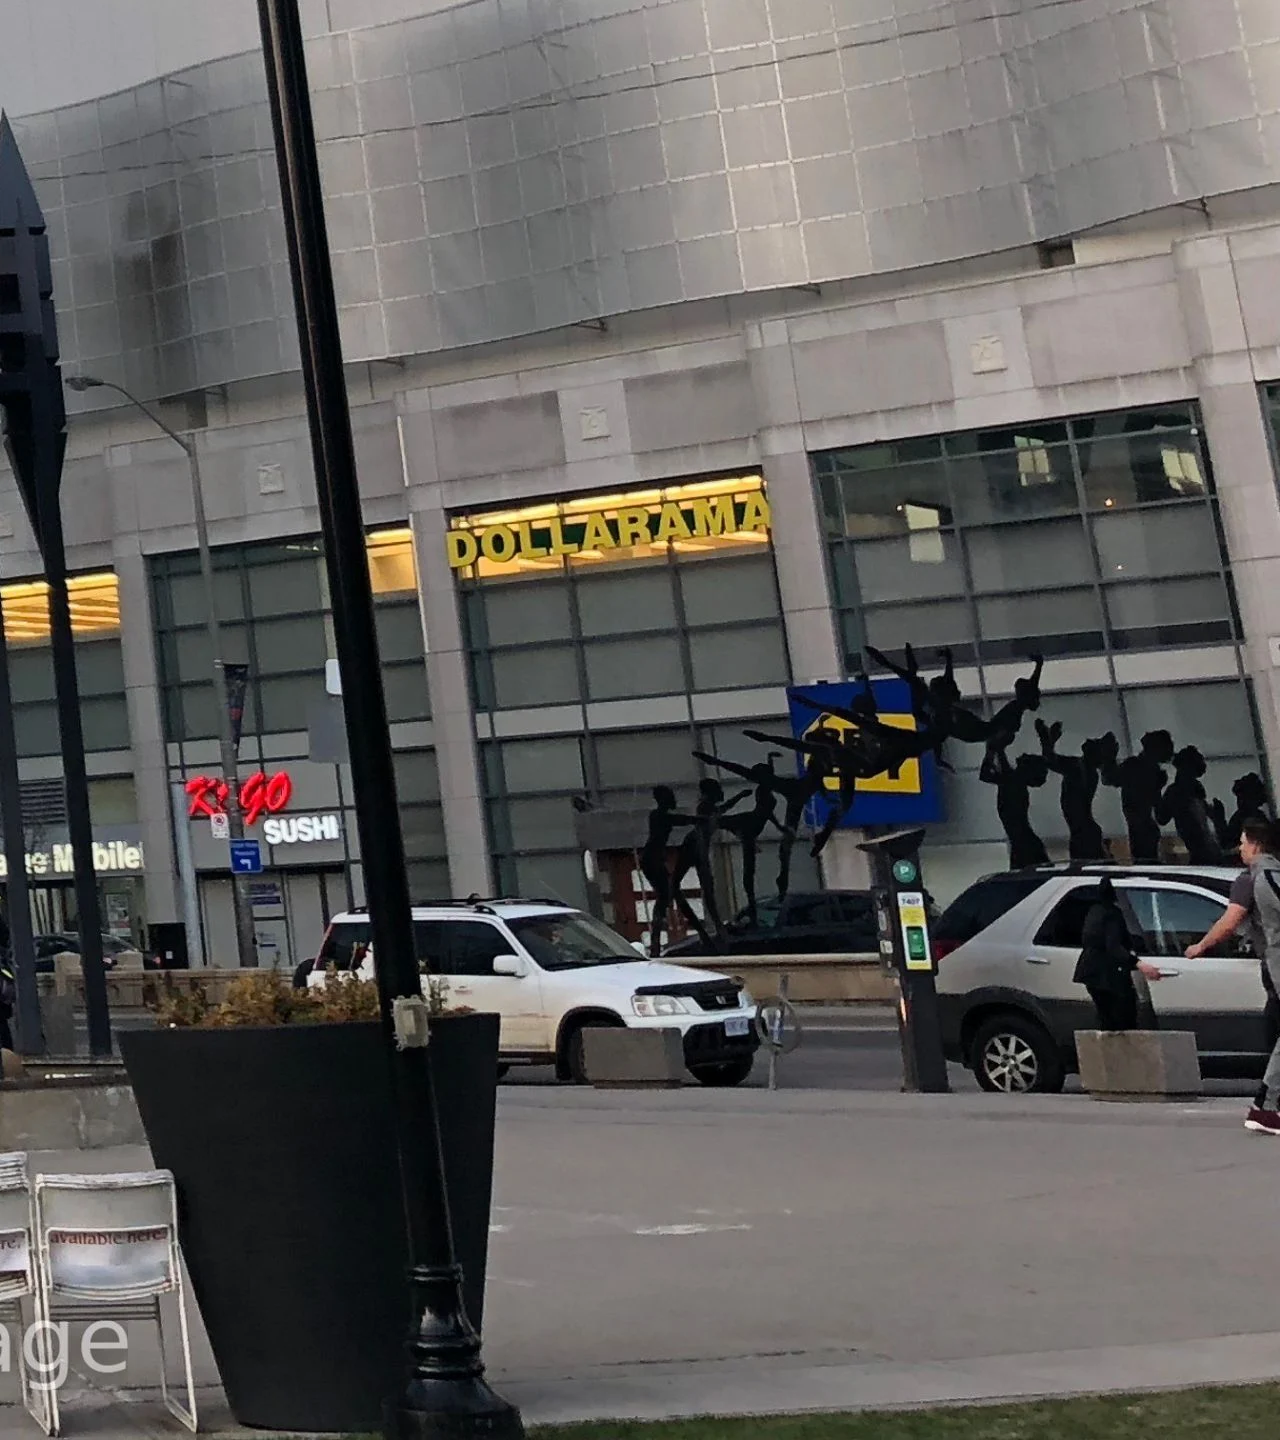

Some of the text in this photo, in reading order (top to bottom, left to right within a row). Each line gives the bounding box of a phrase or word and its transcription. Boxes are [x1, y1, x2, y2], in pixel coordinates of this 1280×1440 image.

[445, 490, 772, 569] DOLLARAMA
[263, 814, 340, 845] SUSHI
[52, 840, 142, 874] Mbile
